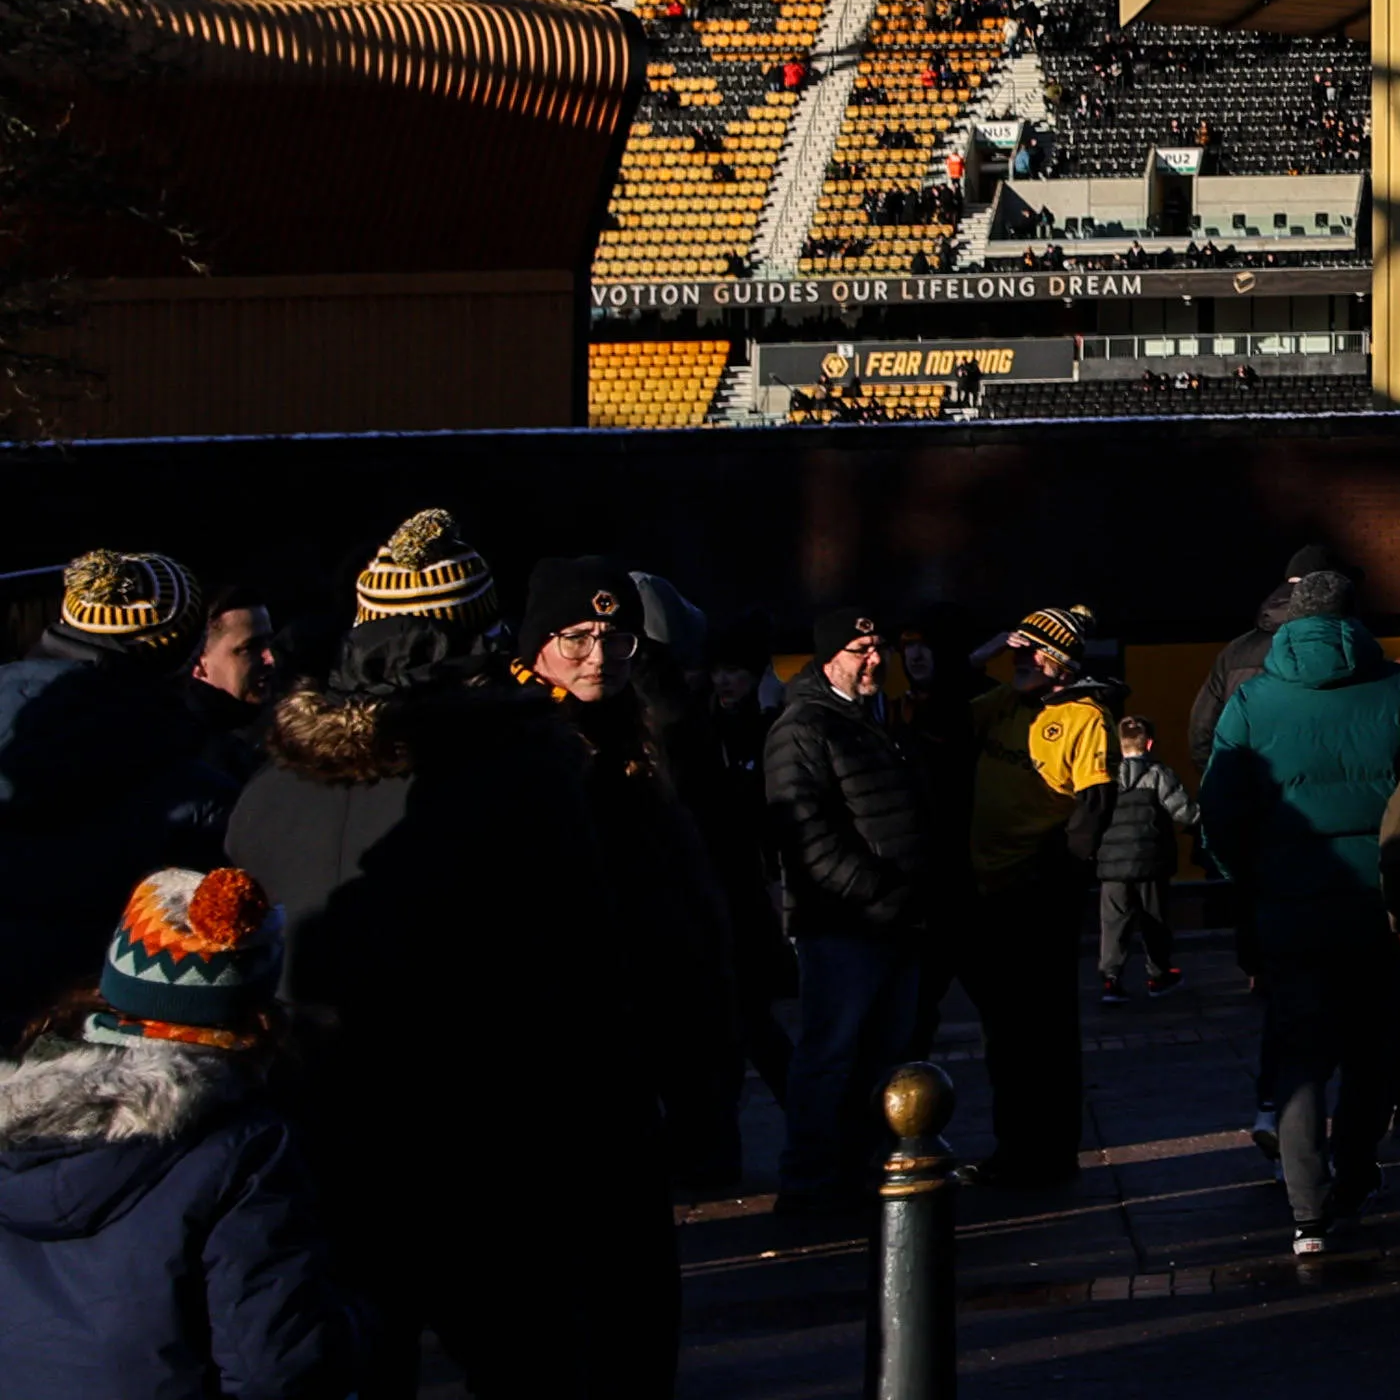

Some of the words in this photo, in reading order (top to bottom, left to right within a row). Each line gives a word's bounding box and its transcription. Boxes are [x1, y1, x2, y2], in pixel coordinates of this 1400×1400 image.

[591, 284, 700, 306] VOTION
[713, 281, 819, 304] GUIDES
[831, 280, 888, 302] OUR
[902, 277, 1036, 301] LIFELONG
[1050, 274, 1142, 296] DREAM
[865, 350, 922, 377] FEAR
